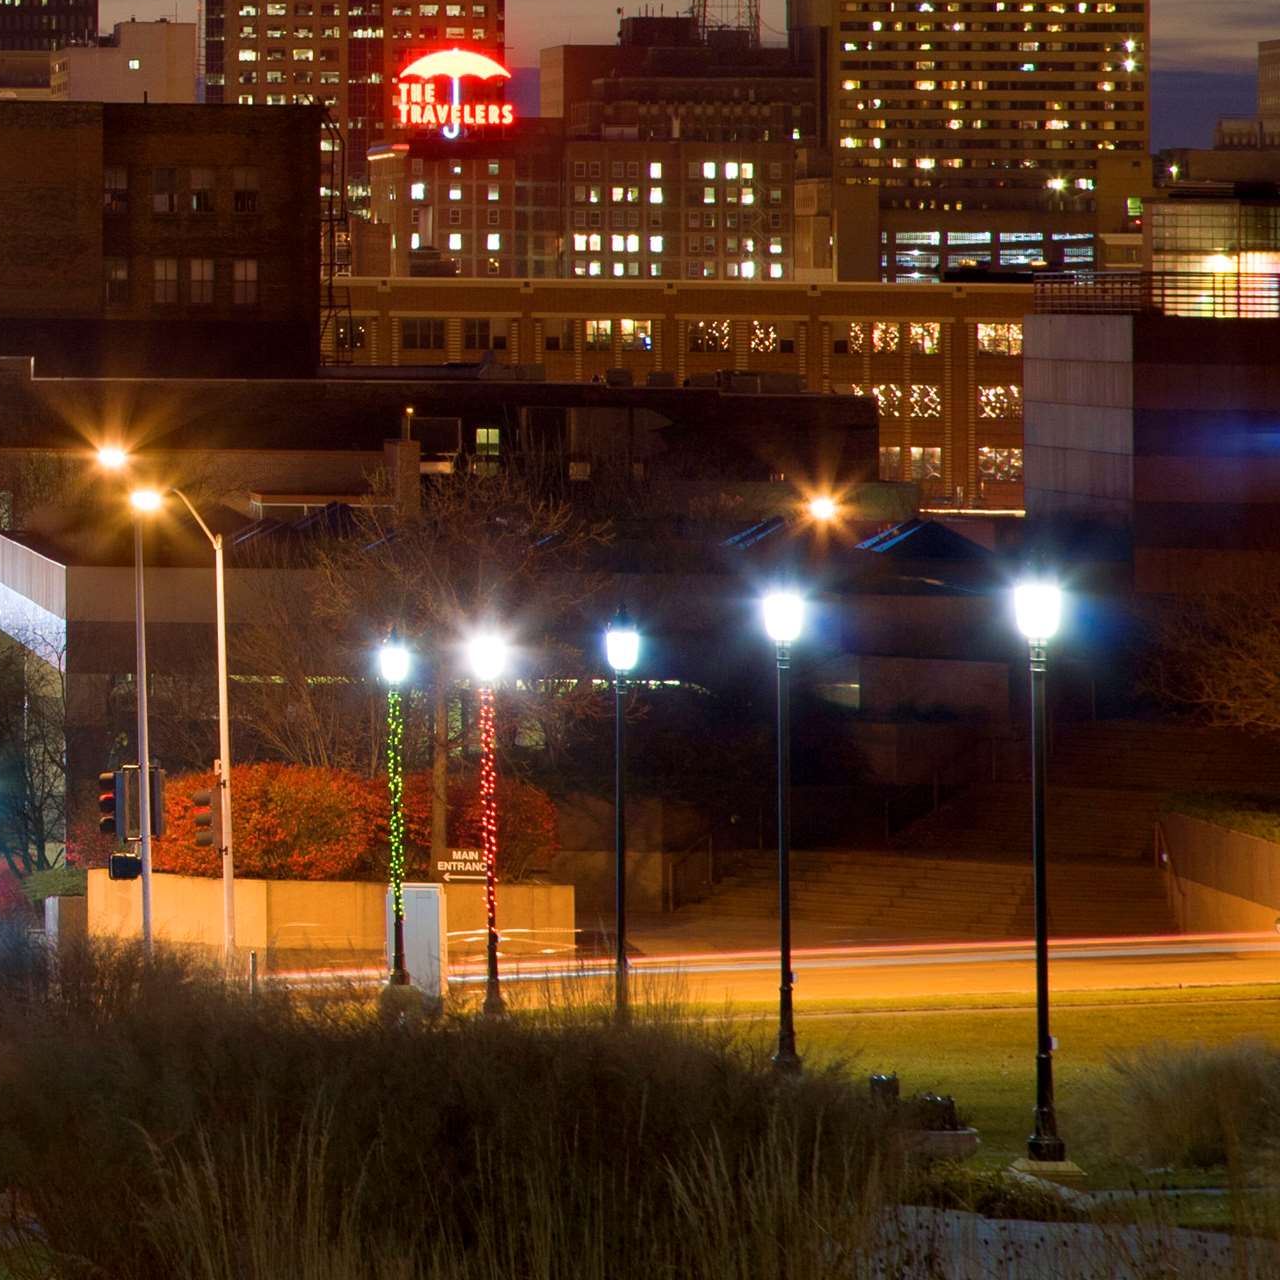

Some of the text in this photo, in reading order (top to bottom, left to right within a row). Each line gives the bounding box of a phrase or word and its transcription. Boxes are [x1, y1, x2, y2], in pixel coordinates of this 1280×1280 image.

[398, 83, 435, 103] THE
[398, 105, 513, 124] TRAVELERS
[452, 850, 479, 860] MAIN
[437, 861, 487, 871] ENTRANC
